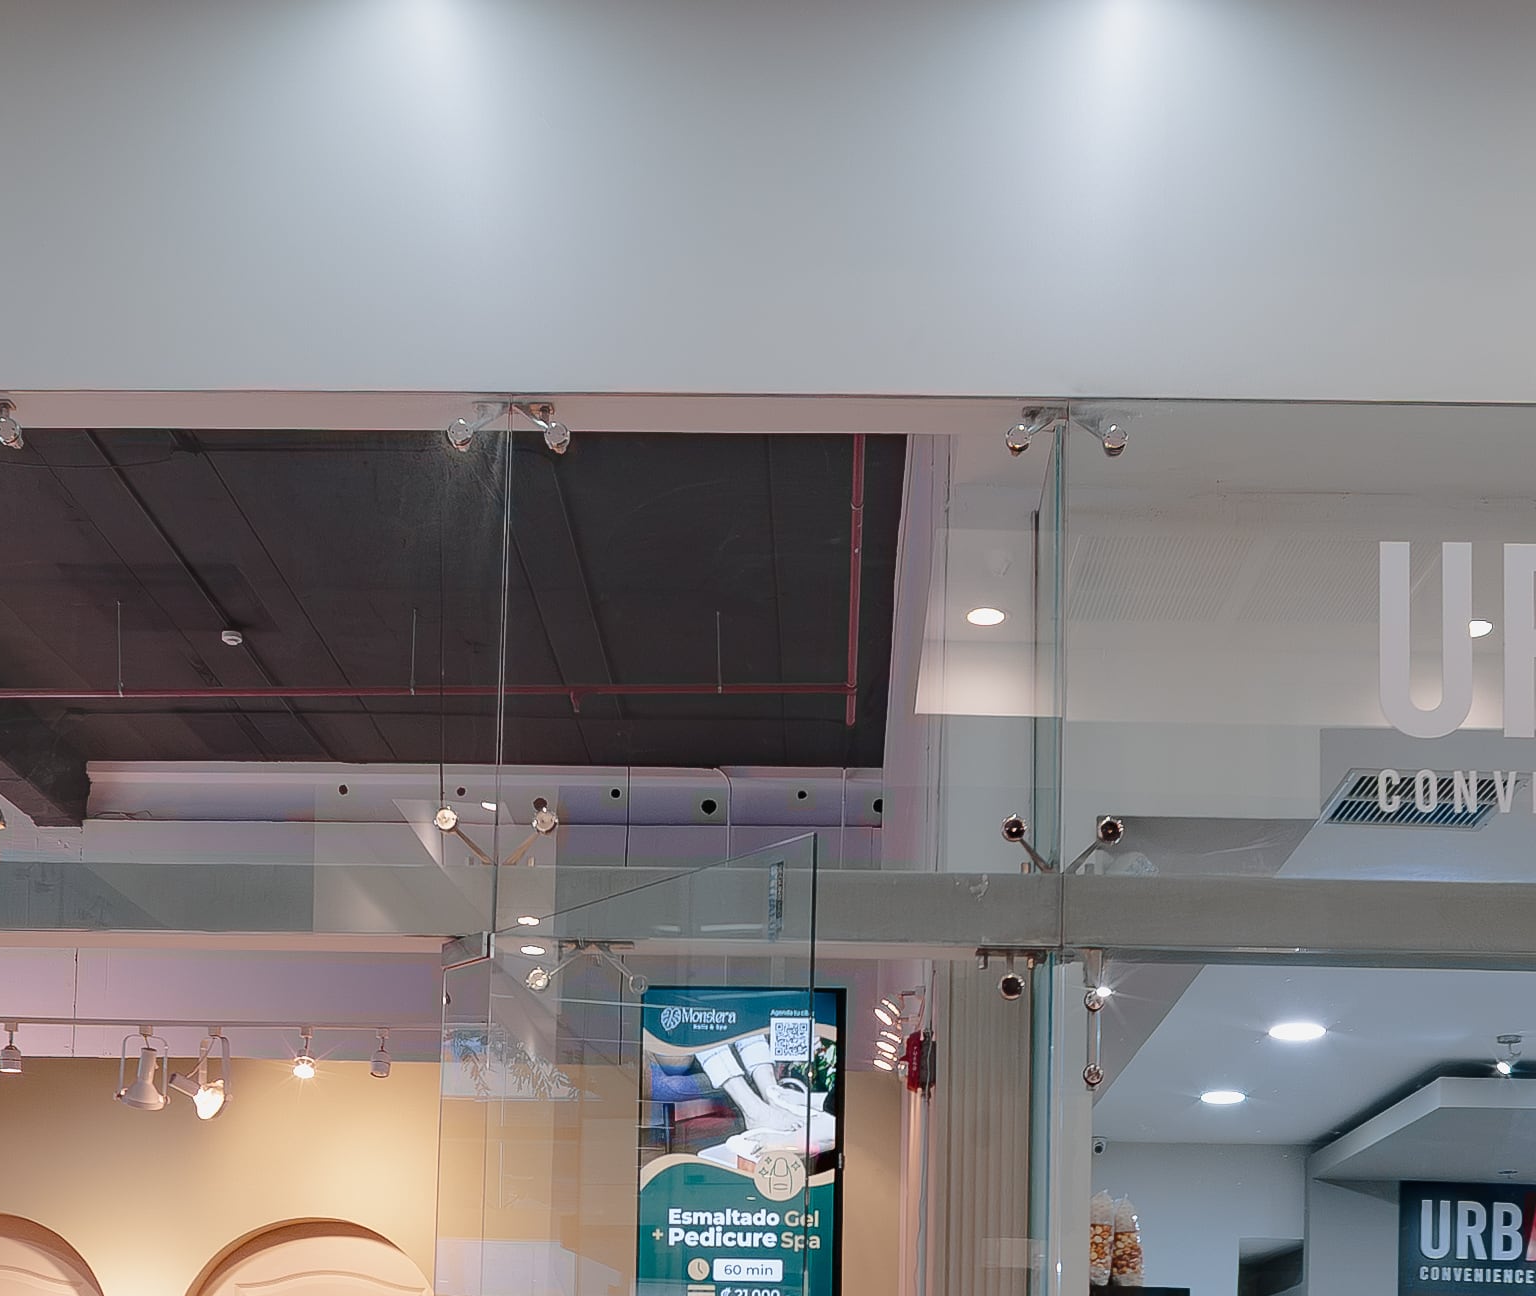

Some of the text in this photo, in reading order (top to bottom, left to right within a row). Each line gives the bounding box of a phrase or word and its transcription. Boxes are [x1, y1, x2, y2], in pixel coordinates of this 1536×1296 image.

[681, 1008, 737, 1025] Monstera
[667, 1208, 820, 1228] Esmaltado Gel
[652, 1226, 822, 1252] + Pedicure Spa
[724, 1263, 774, 1276] 60 min
[1419, 1266, 1536, 1285] CONVENIENCE
